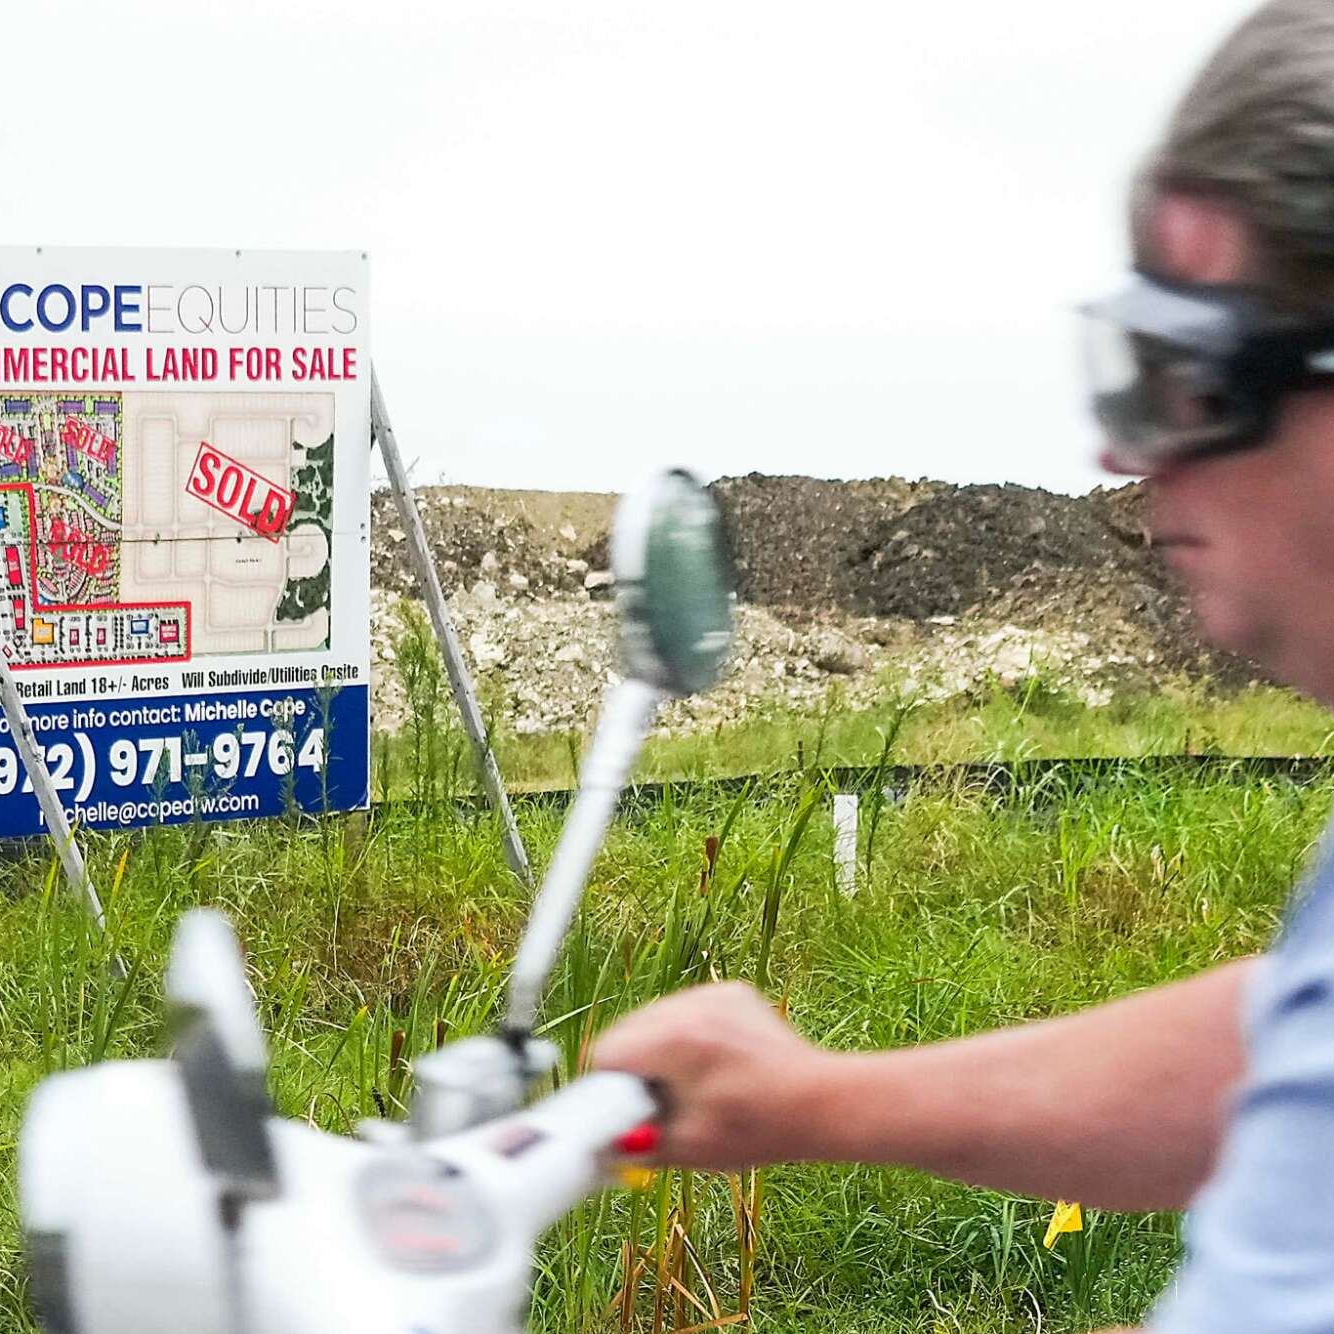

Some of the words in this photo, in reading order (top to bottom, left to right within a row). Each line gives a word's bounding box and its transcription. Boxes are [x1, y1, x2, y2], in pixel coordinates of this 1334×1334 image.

[146, 346, 219, 383] LAND
[230, 346, 283, 382] FOR
[292, 347, 358, 381] SALE
[193, 452, 286, 534] SOLD
[57, 678, 86, 696] Land
[91, 676, 127, 694] 18+/-
[131, 675, 169, 692] Acres
[182, 672, 204, 689] Will
[208, 666, 318, 688] Subdivide/Utilities
[73, 707, 106, 729] info
[109, 705, 181, 728] contact:
[185, 699, 258, 722] Michelle
[260, 698, 306, 723] Cope
[109, 728, 329, 786] 971-9764
